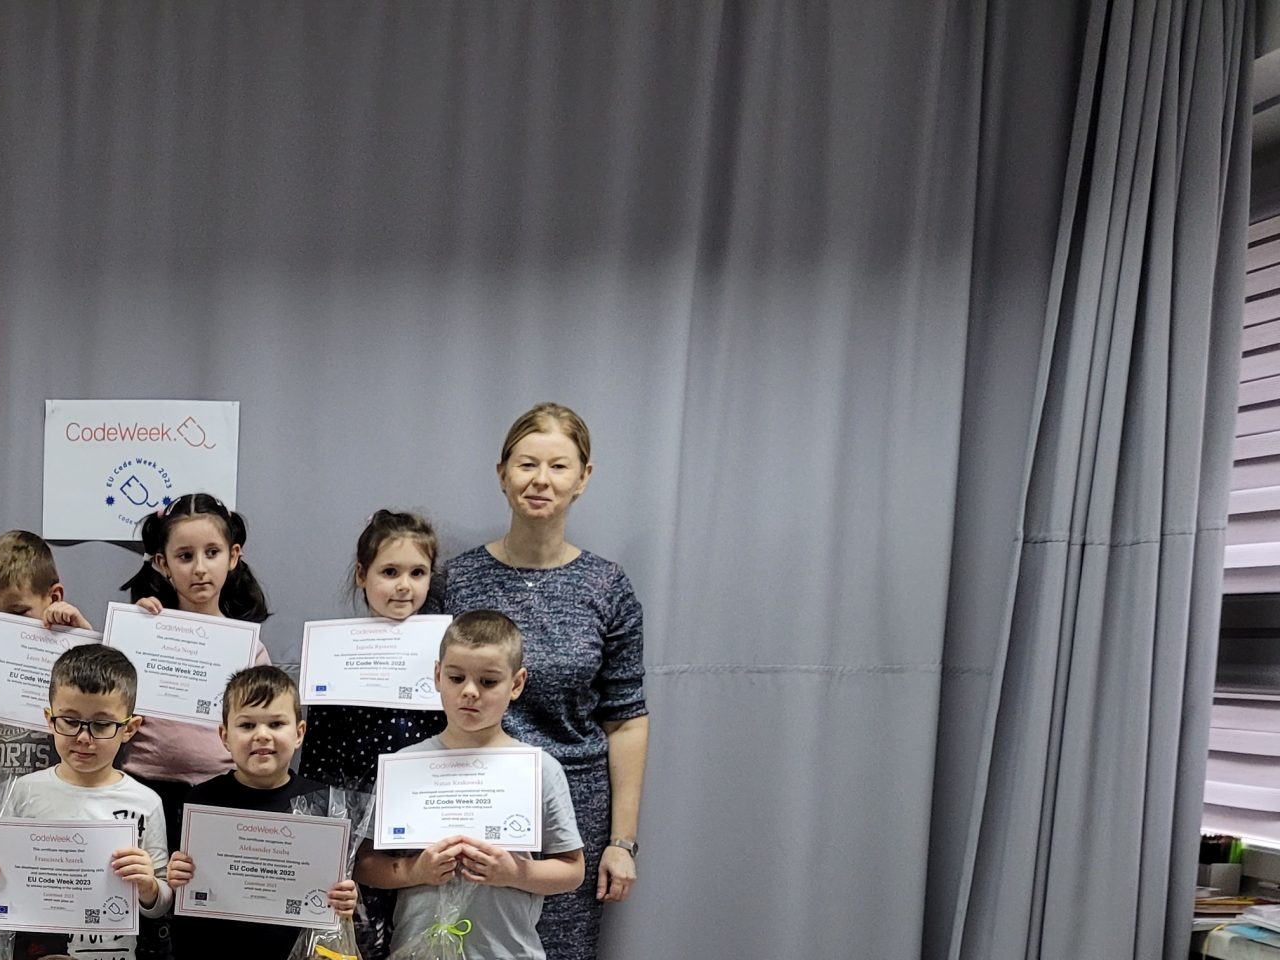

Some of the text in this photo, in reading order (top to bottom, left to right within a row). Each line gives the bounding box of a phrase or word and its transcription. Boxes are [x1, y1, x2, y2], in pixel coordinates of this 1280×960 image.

[106, 458, 172, 489] EU Code Week 2023
[157, 664, 173, 672] Code
[175, 666, 191, 675] Week
[241, 865, 258, 873] Code
